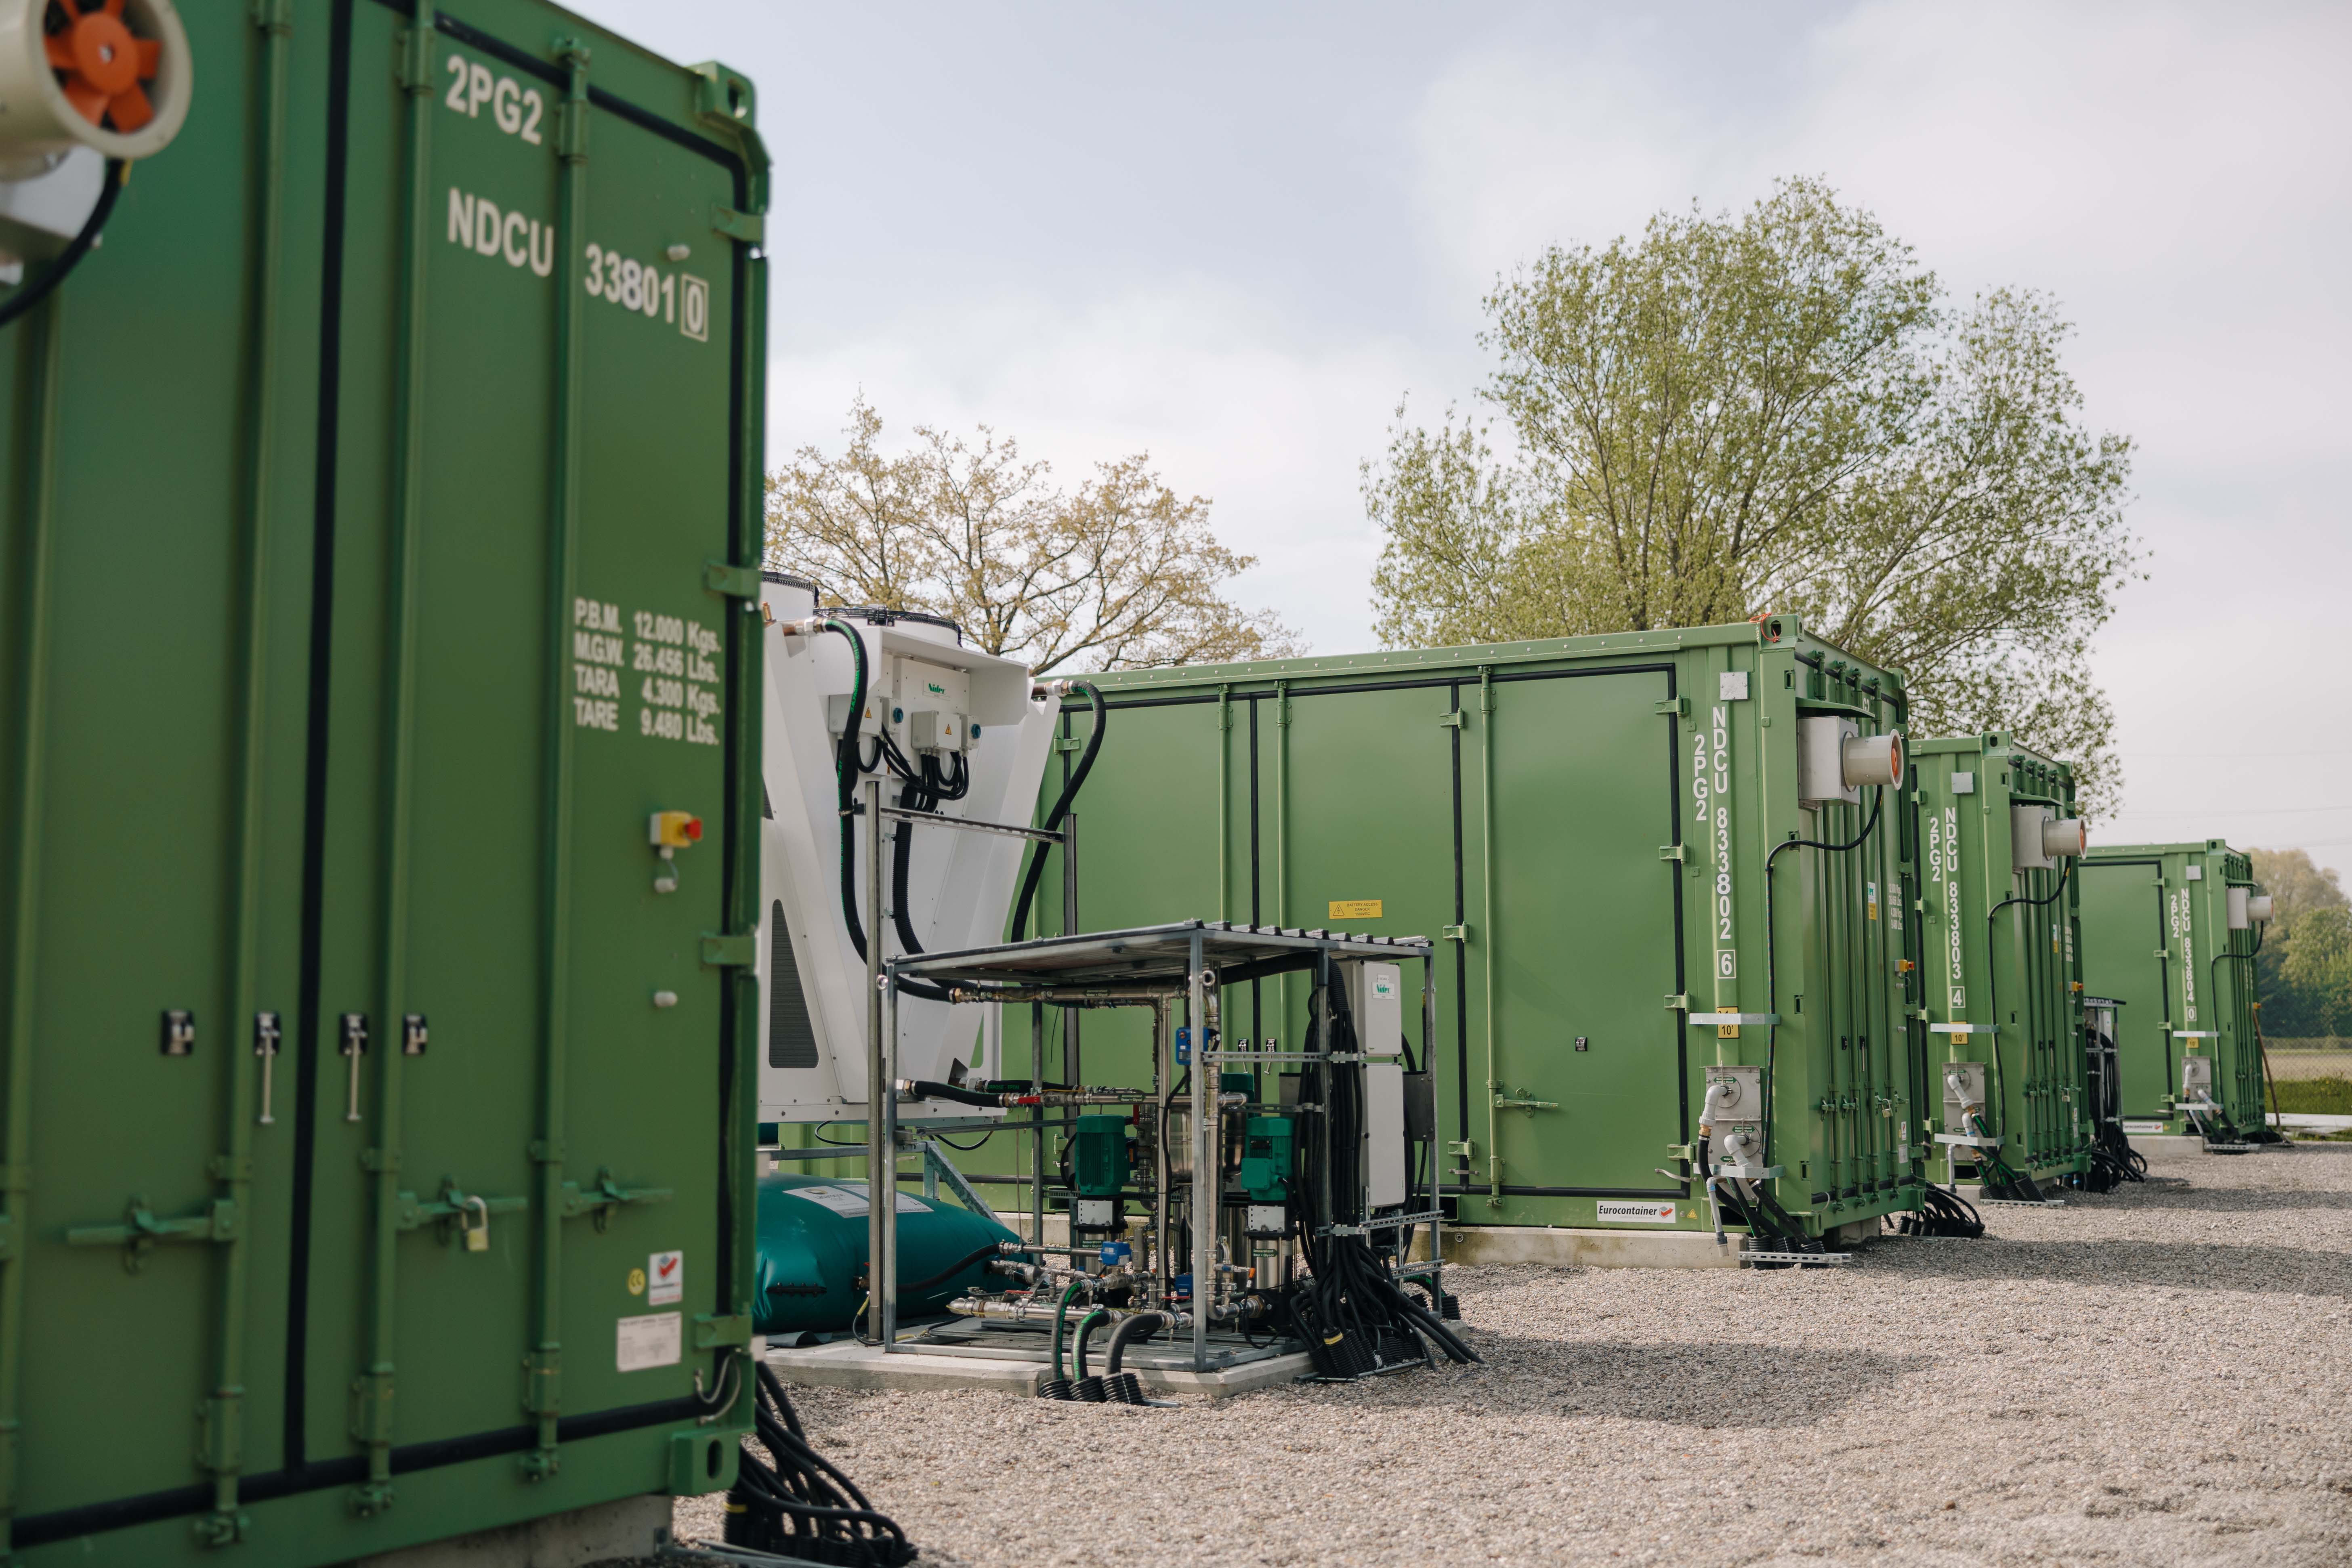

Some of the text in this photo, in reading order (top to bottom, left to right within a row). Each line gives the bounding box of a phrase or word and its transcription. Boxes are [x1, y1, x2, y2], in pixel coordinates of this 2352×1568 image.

[445, 55, 542, 145] 2PG2
[448, 188, 553, 277] NDCU
[633, 641, 684, 677] 26.456
[687, 652, 720, 683] Lbs.
[634, 611, 684, 646] 12.000
[687, 619, 722, 657] Kgs.
[573, 662, 722, 719] TARA 4.300 Kgs.
[573, 696, 720, 746] TARE 9.480 Lbs.
[1693, 734, 1707, 821] 2PG2
[1712, 706, 1734, 977] NDCU 833802 6
[1929, 817, 1941, 882] 2PG2
[1945, 807, 1964, 1008] NDCU 833803 4
[2171, 894, 2180, 938] 2PG2
[2181, 888, 2191, 932] NDCU
[1376, 984, 1391, 993] Nidec
[2183, 937, 2194, 1002] 833804
[1599, 1205, 1657, 1215] Eurocontainer
